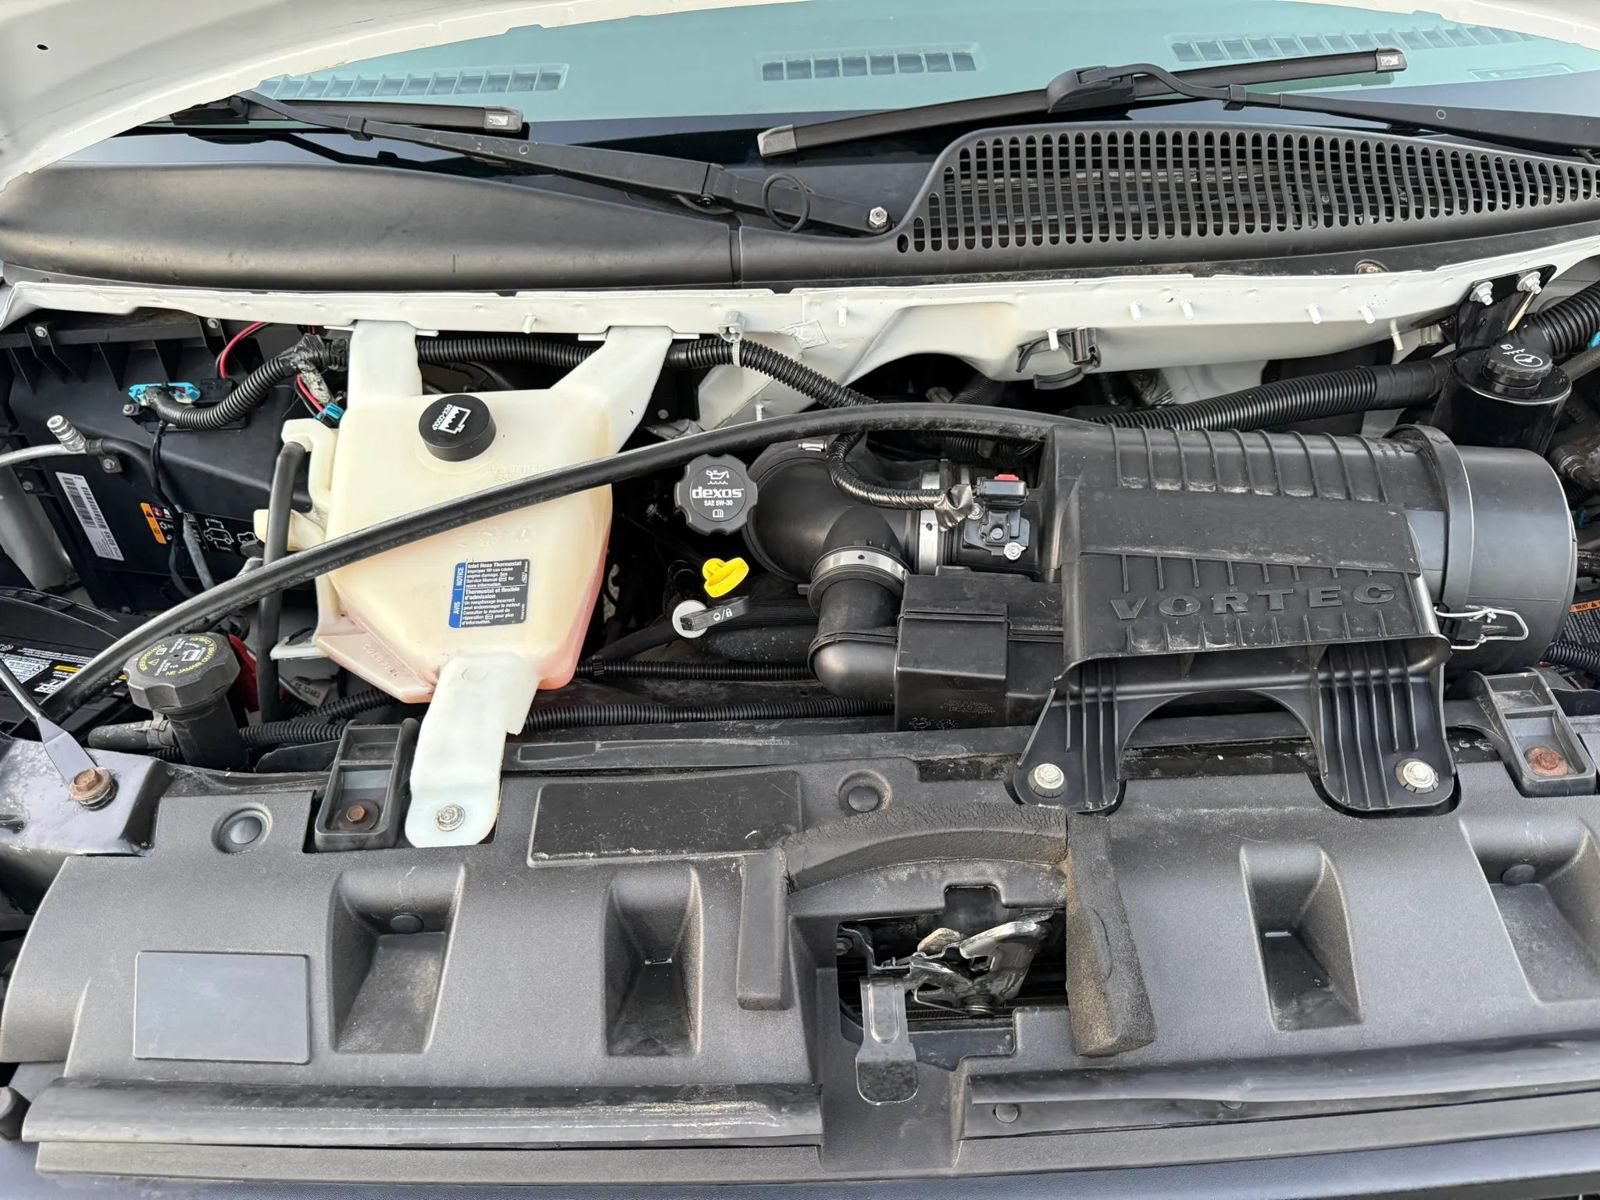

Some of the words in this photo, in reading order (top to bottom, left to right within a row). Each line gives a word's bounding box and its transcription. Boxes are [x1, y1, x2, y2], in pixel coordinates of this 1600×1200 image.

[692, 486, 744, 498] dexos
[456, 567, 464, 586] NOTICE
[453, 601, 461, 614] AVIS
[1110, 582, 1395, 620] VORTEC
